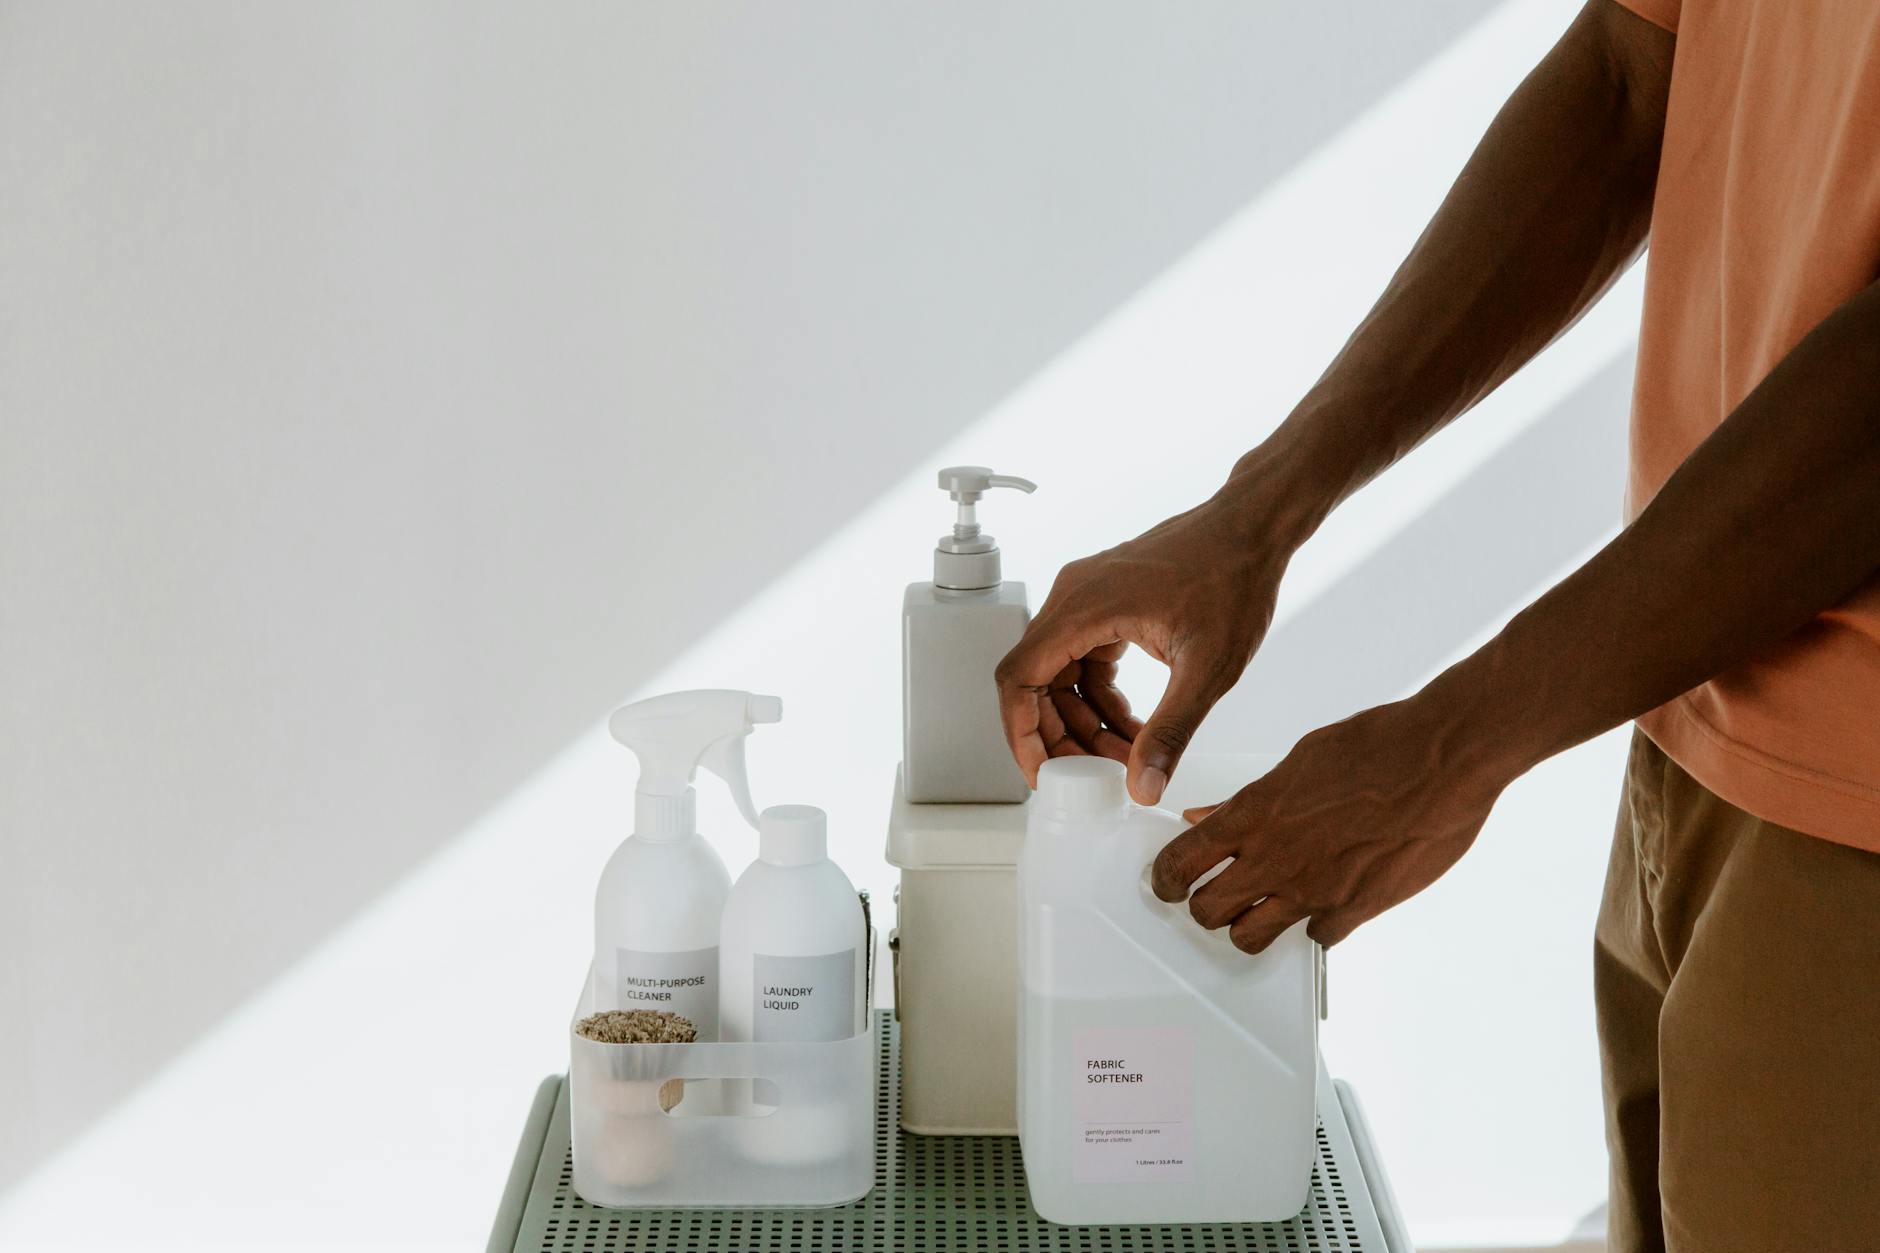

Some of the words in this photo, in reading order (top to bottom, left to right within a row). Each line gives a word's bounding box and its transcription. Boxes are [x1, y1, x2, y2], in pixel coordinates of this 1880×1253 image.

[627, 976, 705, 988] MULTI-PURPOSE
[627, 990, 672, 1001] CLEANER
[763, 986, 813, 997] LAUNDRY
[763, 1000, 800, 1010] LIQUID
[1087, 1060, 1126, 1069] FABRIC
[1087, 1074, 1143, 1083] SOFTENER
